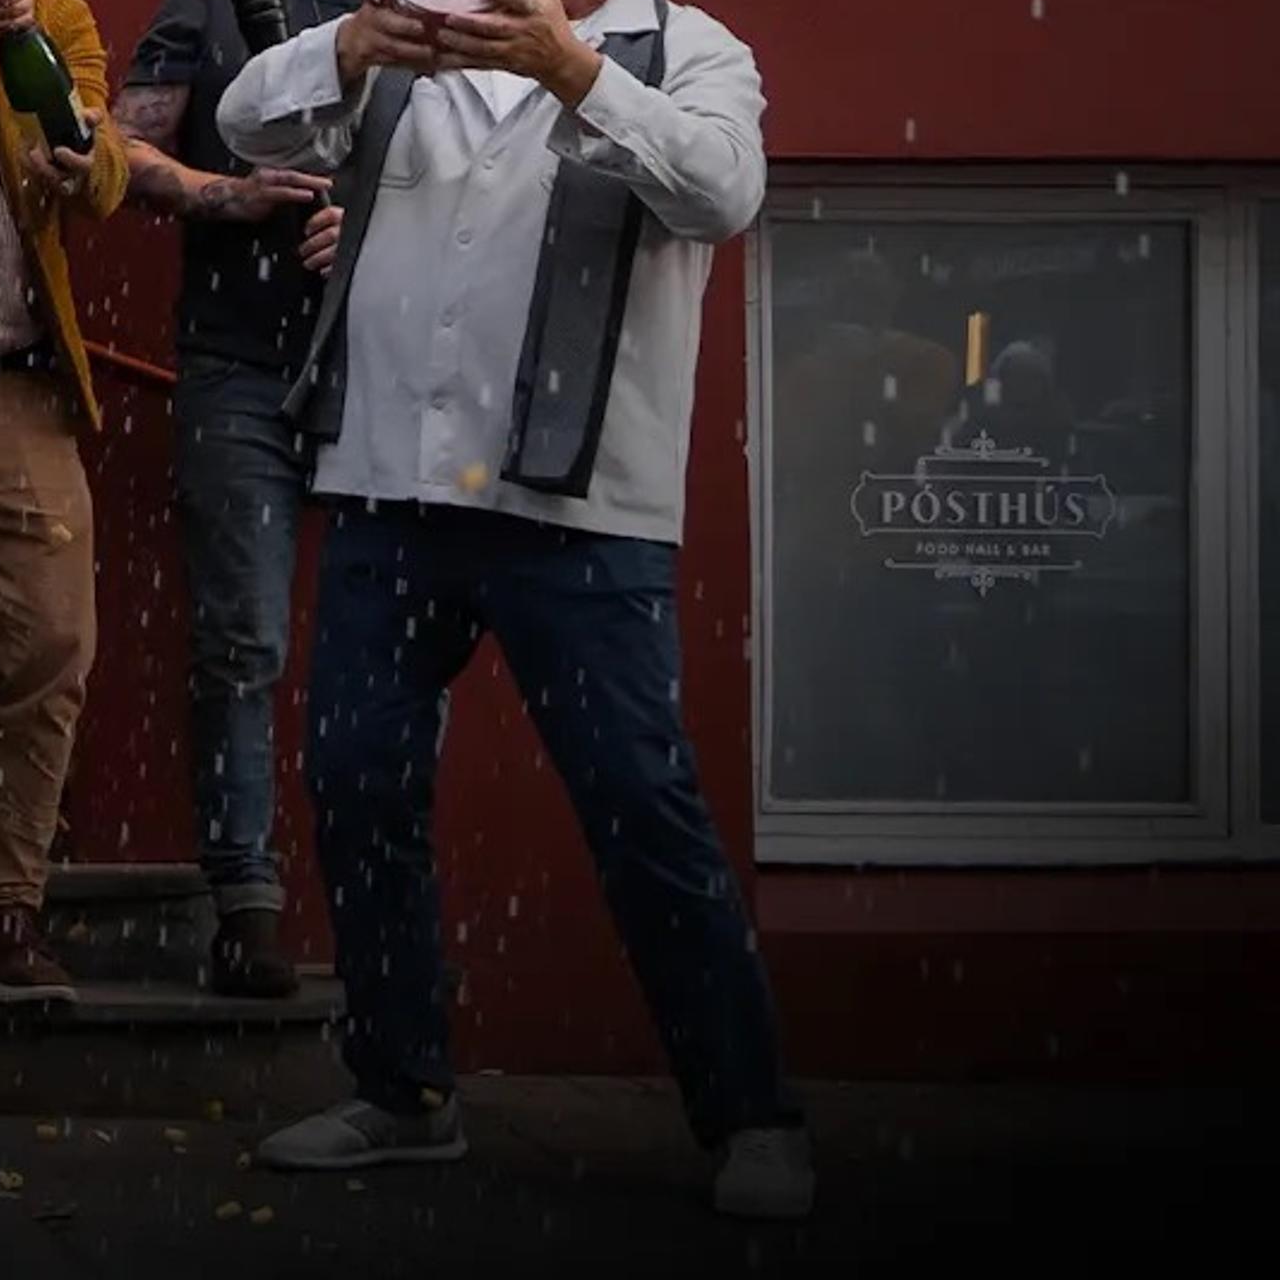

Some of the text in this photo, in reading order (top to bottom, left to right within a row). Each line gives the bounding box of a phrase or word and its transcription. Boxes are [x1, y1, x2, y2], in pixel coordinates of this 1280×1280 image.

[880, 484, 1085, 525] PÓSTHÚS
[915, 542, 960, 555] FOOD
[965, 543, 1001, 556] HALL
[1021, 544, 1051, 556] BAR
